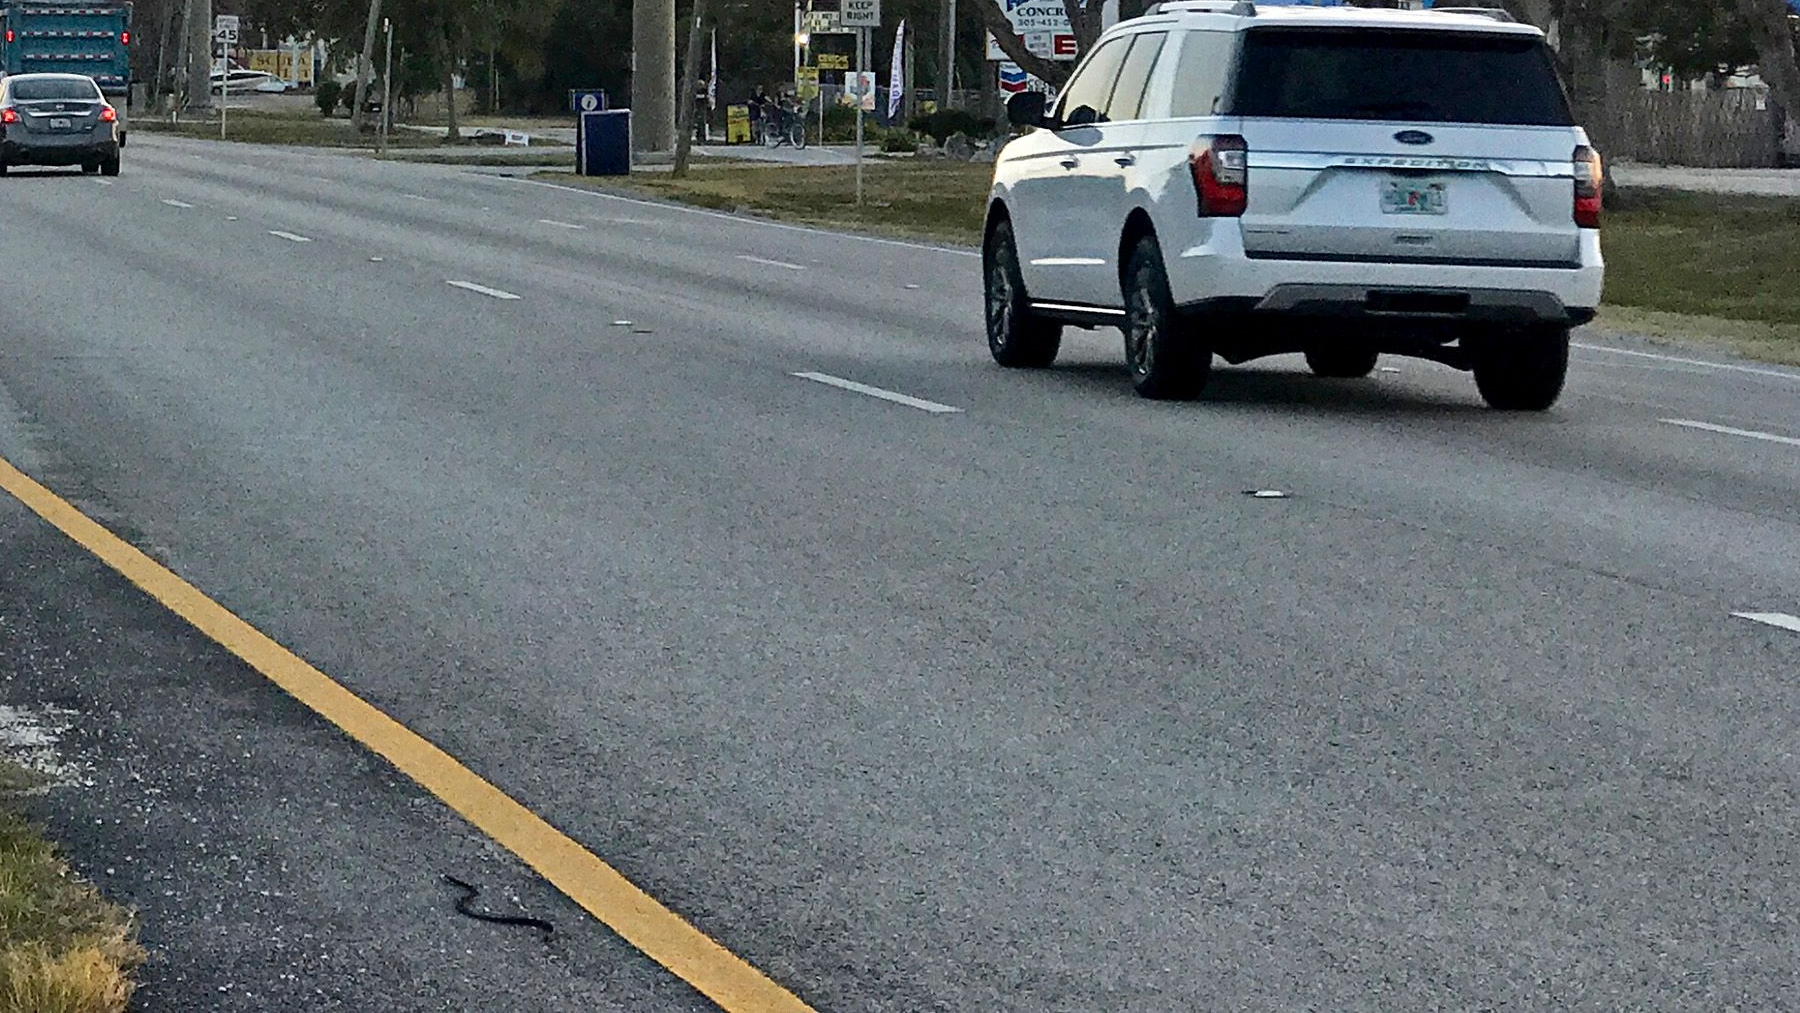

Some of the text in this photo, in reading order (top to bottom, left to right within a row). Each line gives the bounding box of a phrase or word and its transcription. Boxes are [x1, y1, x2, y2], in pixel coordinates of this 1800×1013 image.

[848, 1, 874, 10] KEEP
[846, 11, 874, 20] RIGHT
[217, 29, 237, 41] 45
[1343, 157, 1490, 169] EXPEDITION
